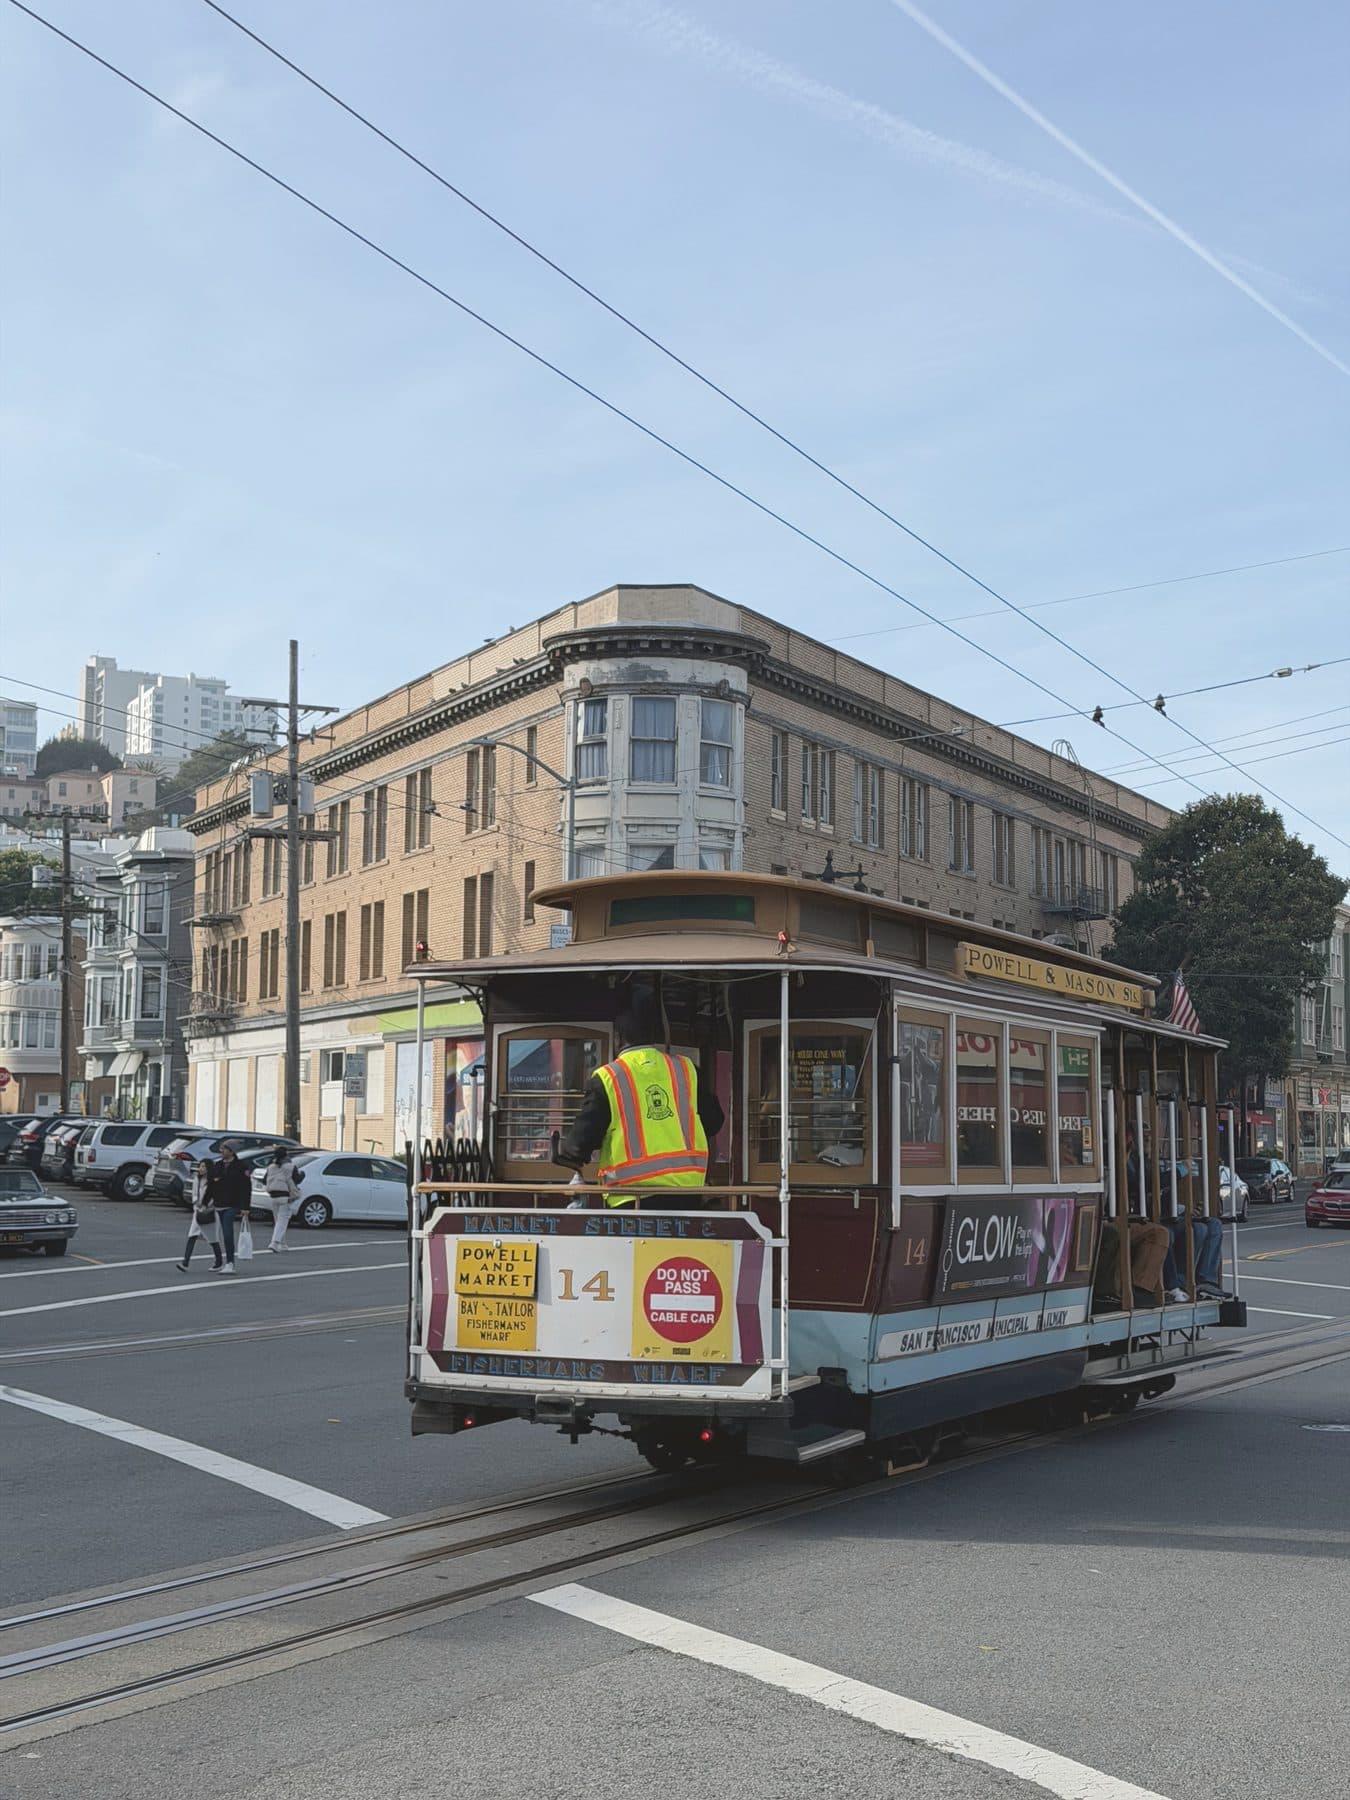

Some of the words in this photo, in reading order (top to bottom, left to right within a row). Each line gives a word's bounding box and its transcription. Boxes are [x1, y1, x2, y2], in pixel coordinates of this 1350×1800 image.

[968, 948, 1038, 982] POWELL
[1045, 966, 1057, 985] &
[1064, 971, 1115, 998] MASON
[463, 1215, 561, 1233] MARKET
[583, 1216, 690, 1236] STREET
[956, 1214, 1019, 1264] GLOW
[462, 1247, 533, 1263] POWELL
[903, 1238, 928, 1266] 14
[480, 1261, 514, 1273] AND
[656, 1268, 676, 1282] DO
[679, 1268, 710, 1282] NOT
[459, 1272, 533, 1287] MARKET
[557, 1268, 616, 1302] 14
[664, 1281, 701, 1294] PASS
[460, 1300, 478, 1315] BAY
[495, 1301, 534, 1317] TAYLOR
[466, 1318, 527, 1331] FISHERMANS
[650, 1311, 689, 1323] CABLE
[691, 1312, 715, 1324] CAR
[479, 1331, 511, 1342] WHARF
[900, 1329, 923, 1352] SAN
[450, 1354, 606, 1381] FISHERMANS
[632, 1361, 727, 1385] WHARF
